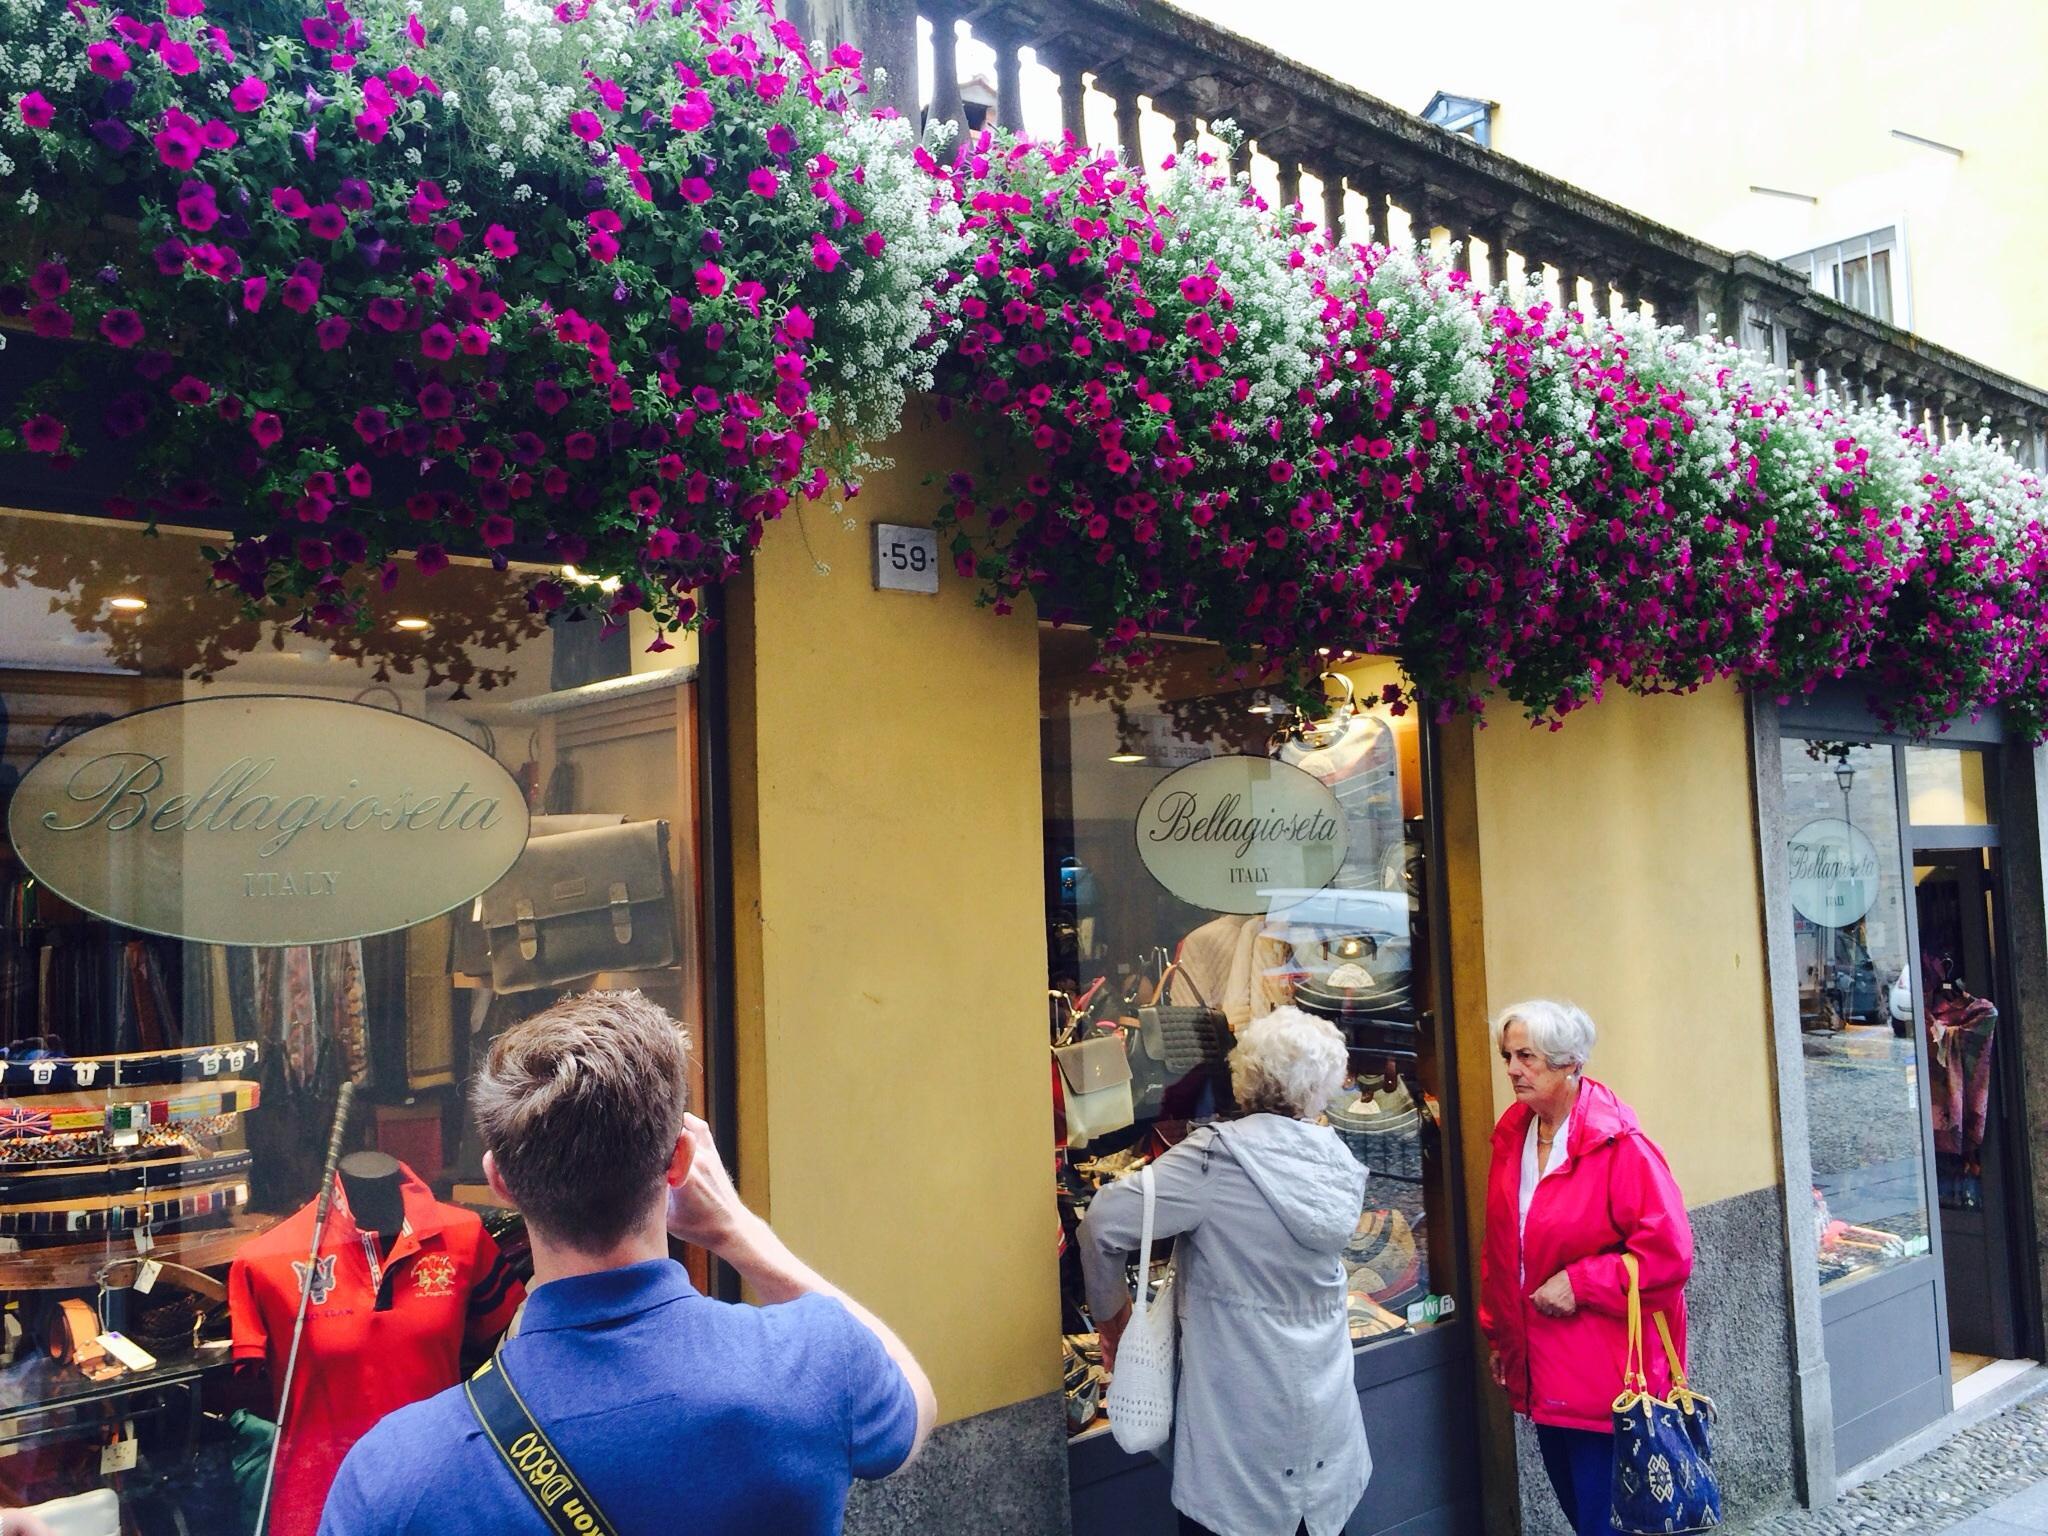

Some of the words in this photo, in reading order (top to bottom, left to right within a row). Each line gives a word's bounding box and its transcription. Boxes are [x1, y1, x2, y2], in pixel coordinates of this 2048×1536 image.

[891, 543, 927, 572] 59
[42, 751, 503, 858] Bellagioseta
[1149, 791, 1338, 859] Bellagioseta
[242, 871, 341, 898] ITALY
[1230, 867, 1271, 884] ITALY
[207, 1059, 217, 1071] 5
[233, 1056, 241, 1067] 6
[1424, 1299, 1439, 1317] Wi
[1443, 1296, 1453, 1311] Fi
[509, 1432, 574, 1507] D600
